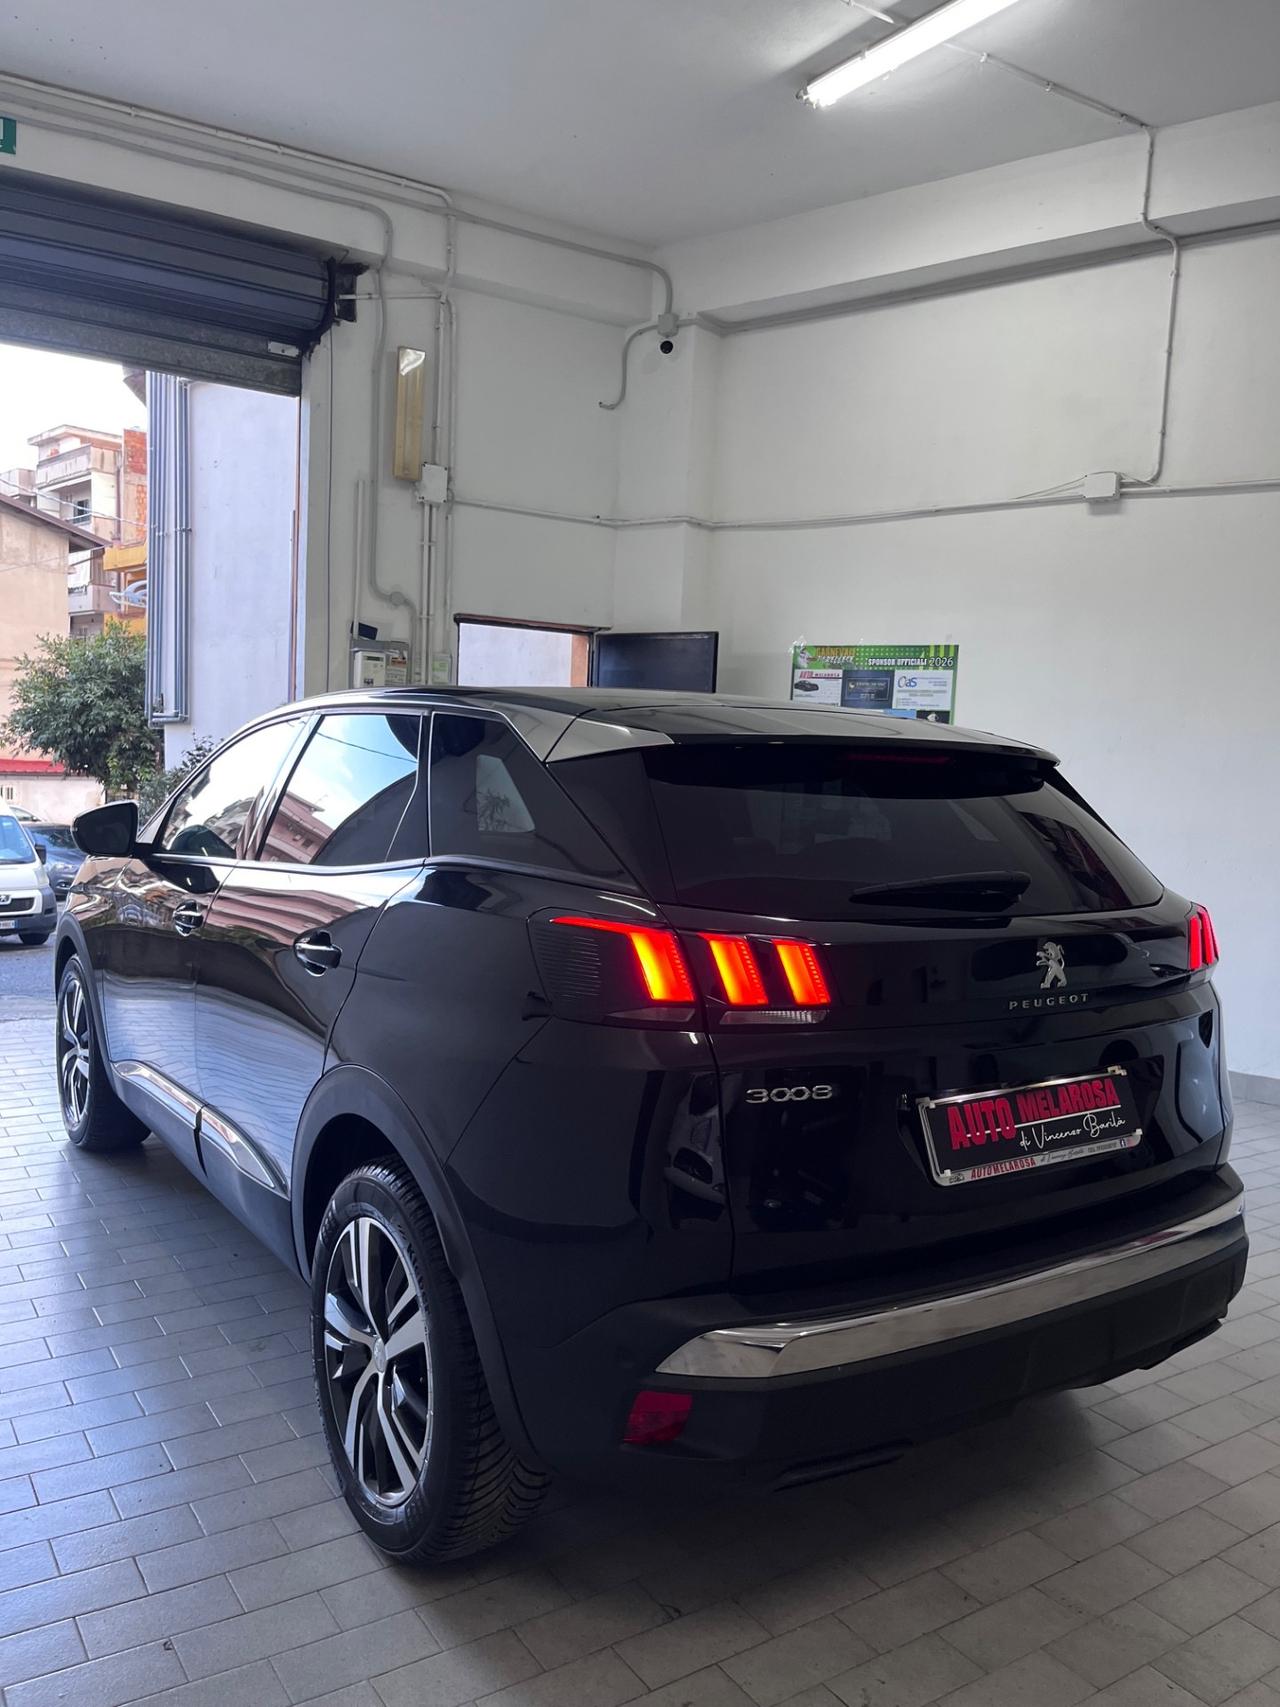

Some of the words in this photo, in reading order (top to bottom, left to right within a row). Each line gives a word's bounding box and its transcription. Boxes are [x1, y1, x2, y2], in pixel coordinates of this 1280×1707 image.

[868, 658, 896, 666] SPONSOR
[929, 657, 954, 667] 2026
[1008, 993, 1089, 1010] PEUGEOT
[745, 1084, 833, 1104] 3008
[947, 1097, 1017, 1150] AUTO
[1015, 1077, 1121, 1123] MELAROSA
[1019, 1129, 1032, 1151] di
[1032, 1123, 1082, 1150] Vincenzo
[1082, 1111, 1126, 1138] Barilà
[970, 1157, 1037, 1180] AUTOMELAROSA
